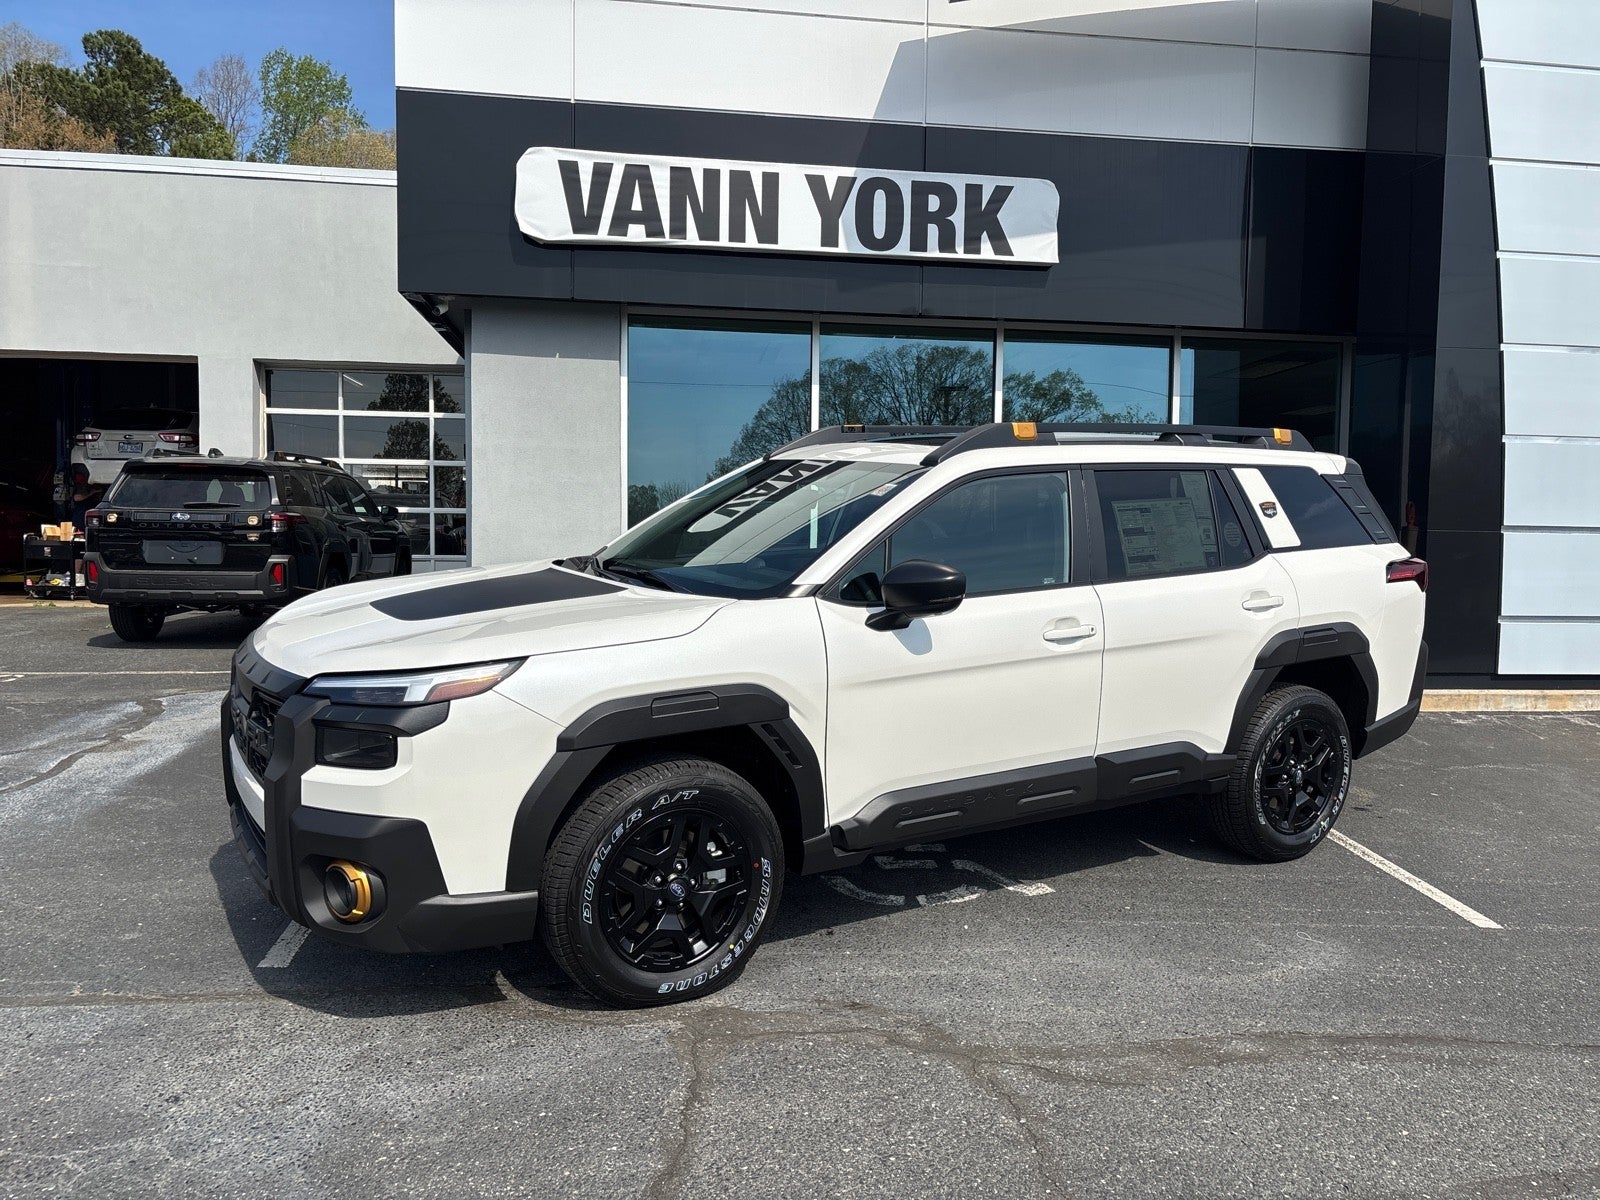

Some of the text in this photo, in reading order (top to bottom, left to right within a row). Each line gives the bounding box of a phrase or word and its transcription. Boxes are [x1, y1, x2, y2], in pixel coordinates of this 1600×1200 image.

[557, 159, 1016, 257] VANN YORK
[138, 522, 222, 530] OUTBACK
[582, 790, 699, 925] DUELER A/T
[657, 856, 772, 994] BRIDGESTONE
